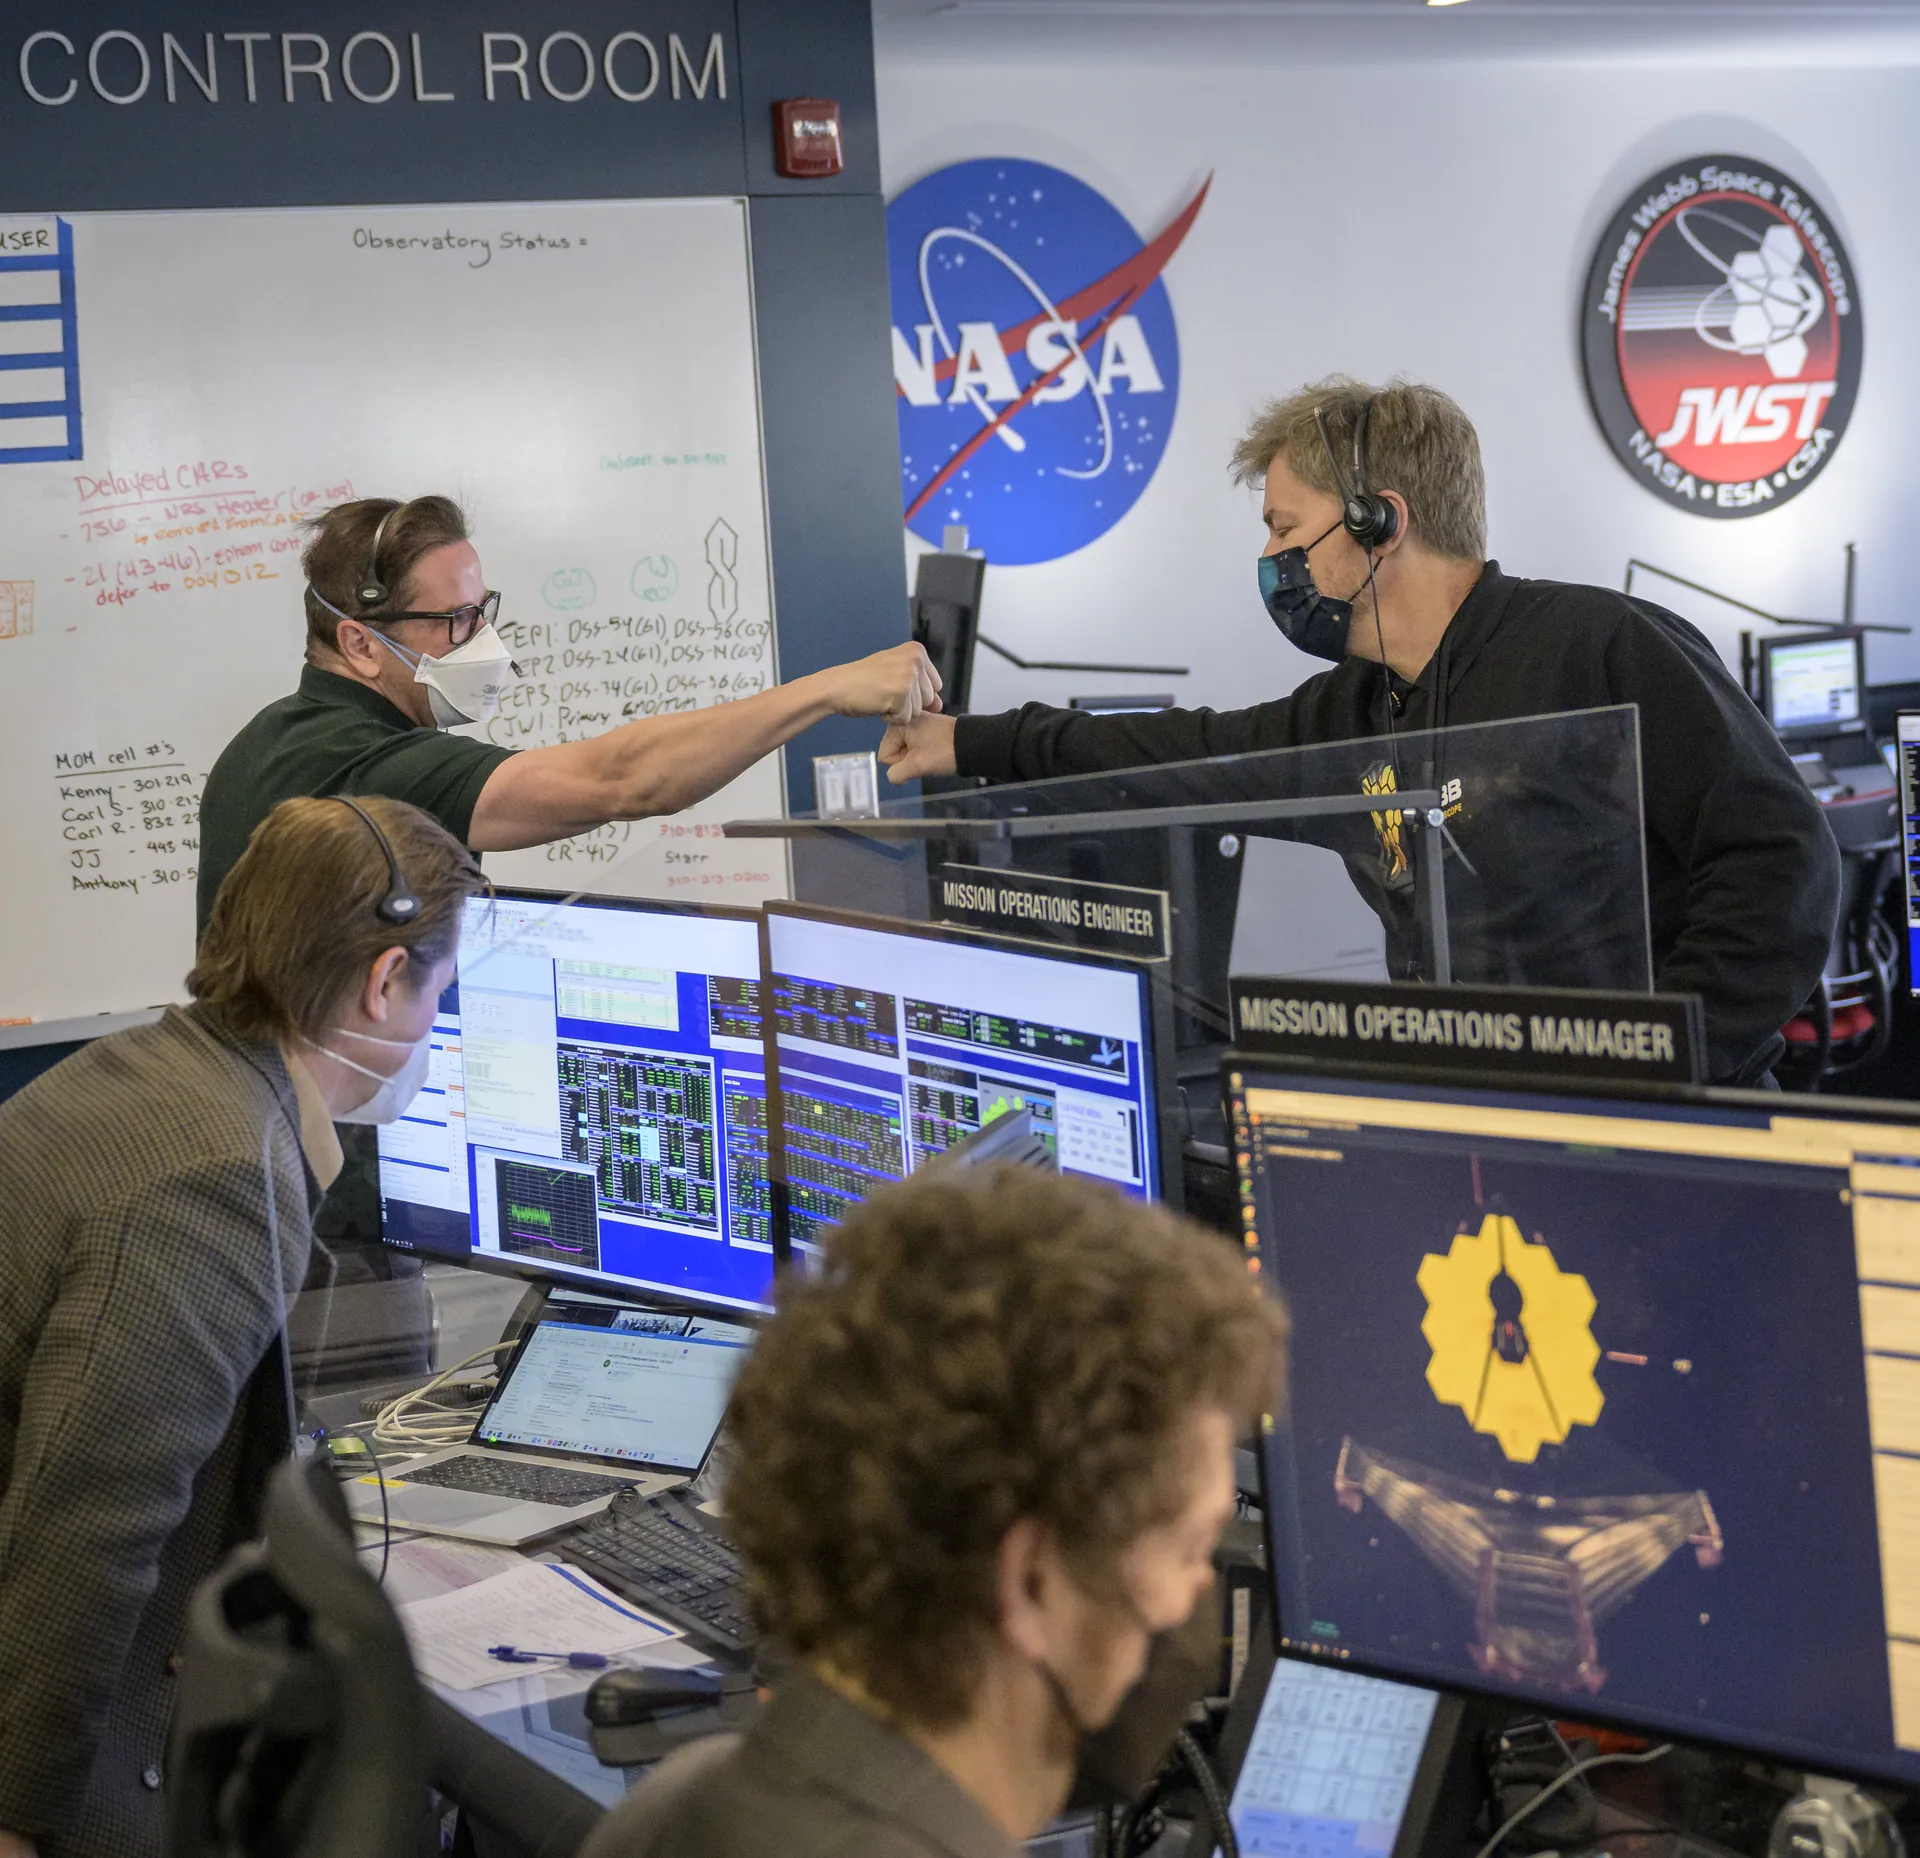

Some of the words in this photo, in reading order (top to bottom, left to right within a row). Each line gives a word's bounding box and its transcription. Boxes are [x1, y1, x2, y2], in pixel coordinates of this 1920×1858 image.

[19, 31, 454, 104] CONTROL
[482, 31, 728, 102] ROOM
[353, 228, 491, 268] Observatory
[500, 231, 570, 250] Status
[1598, 228, 1641, 322] James
[1632, 175, 1698, 228] Webb
[1700, 166, 1776, 200] Space
[1779, 185, 1851, 316] Telescope
[890, 314, 1164, 407] NASA
[1655, 381, 1837, 448] JWST
[73, 467, 170, 501] Delayed
[1629, 430, 1697, 500] NASA
[1717, 478, 1774, 508] ESA
[1787, 427, 1836, 481] CSA
[80, 518, 127, 542] 756
[216, 490, 286, 515] Heater
[148, 580, 171, 592] to
[56, 751, 96, 769] MOM
[109, 747, 136, 763] cell
[60, 786, 113, 804] Kenny
[62, 806, 104, 822] Carl
[63, 826, 103, 841] Carl
[72, 874, 139, 894] Anthony
[943, 881, 996, 914] MISSION
[999, 890, 1081, 927] OPERATIONS
[1084, 902, 1154, 938] ENGINEER
[1239, 995, 1348, 1037] MISSION
[1354, 1003, 1524, 1052] OPERATIONS
[1530, 1014, 1675, 1064] MANAGER
